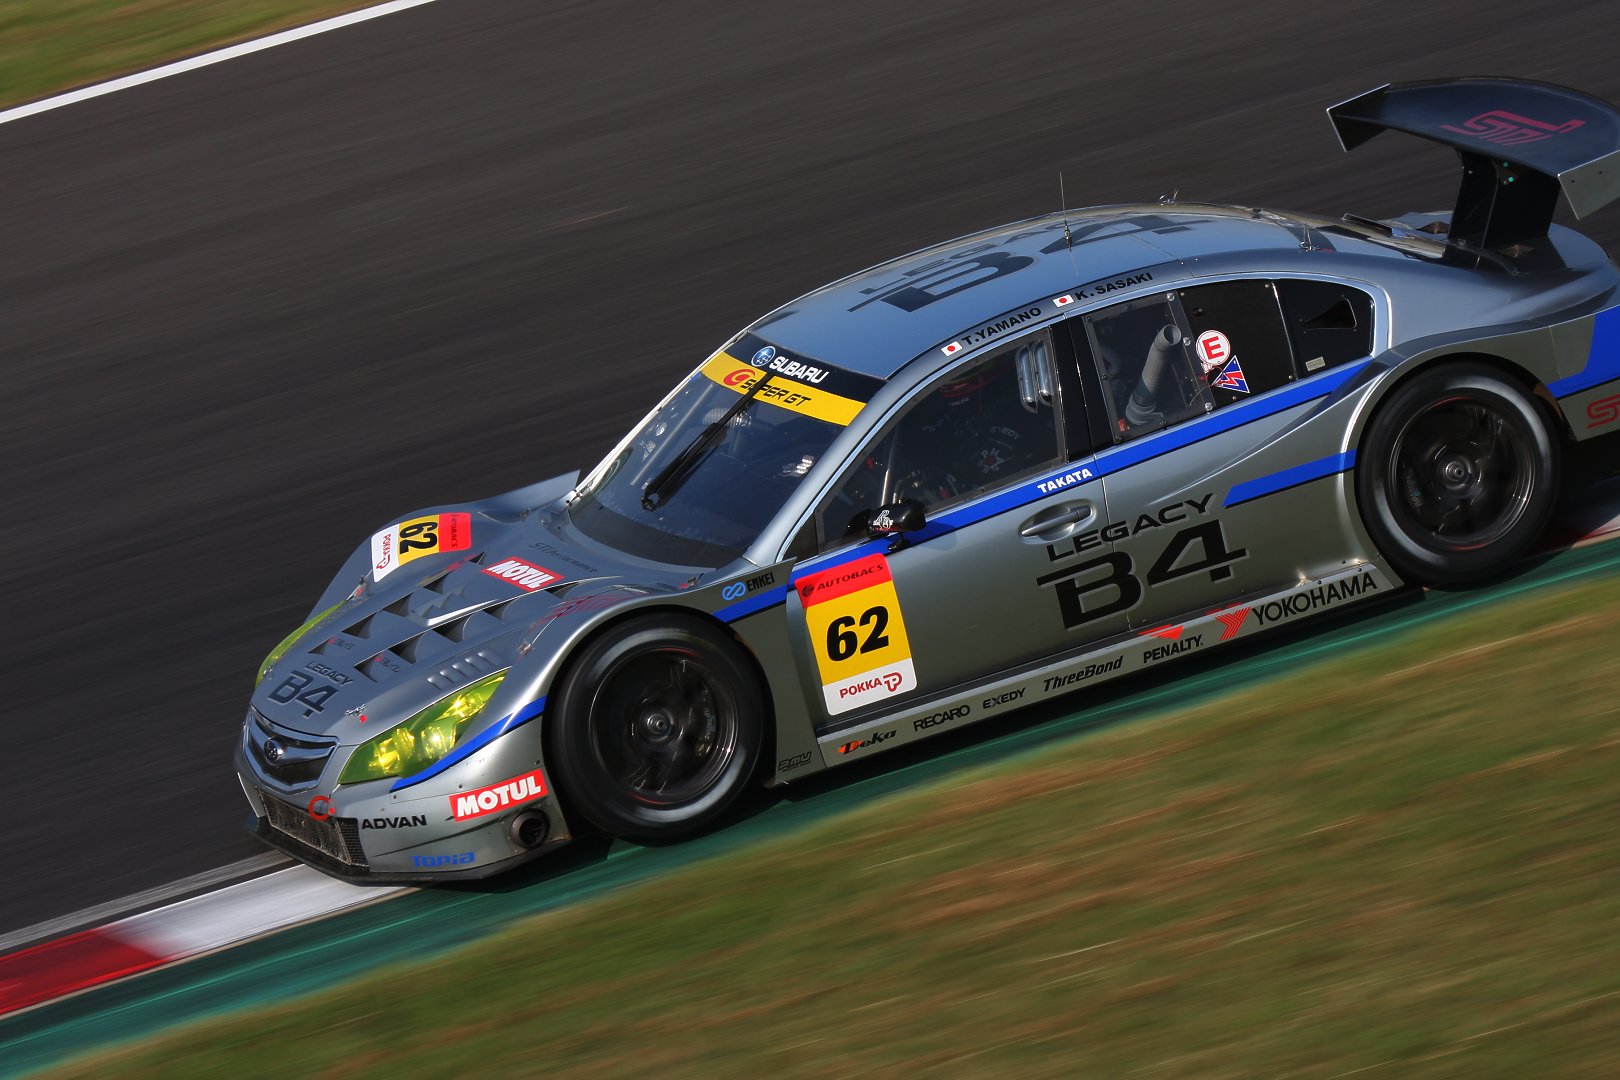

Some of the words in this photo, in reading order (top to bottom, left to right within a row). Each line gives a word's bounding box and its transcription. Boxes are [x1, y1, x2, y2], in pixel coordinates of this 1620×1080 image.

[962, 307, 1041, 345] T.YAMANO
[1202, 336, 1225, 360] E
[769, 356, 829, 384] SUBARU
[741, 379, 789, 400] SPER
[784, 392, 812, 406] GT
[1037, 468, 1093, 494] TAKATA
[400, 521, 438, 555] 62
[1046, 493, 1214, 562] LEGACY
[486, 560, 555, 588] MOTUL
[746, 572, 775, 593] ENKEI
[817, 564, 884, 590] AUTOBACS
[1036, 519, 1248, 630] B4
[1253, 573, 1377, 626] YOKOHAMA
[826, 605, 889, 662] 62
[305, 661, 354, 685] LEGACY
[1044, 655, 1124, 692] ThreeBond
[267, 670, 339, 717] B4
[839, 677, 883, 699] POKKA
[982, 687, 1027, 709] EXEDY
[913, 704, 971, 732] RECARO
[838, 729, 897, 755] Deka
[457, 775, 541, 817] MOTUL
[361, 815, 427, 830] ADVAN
